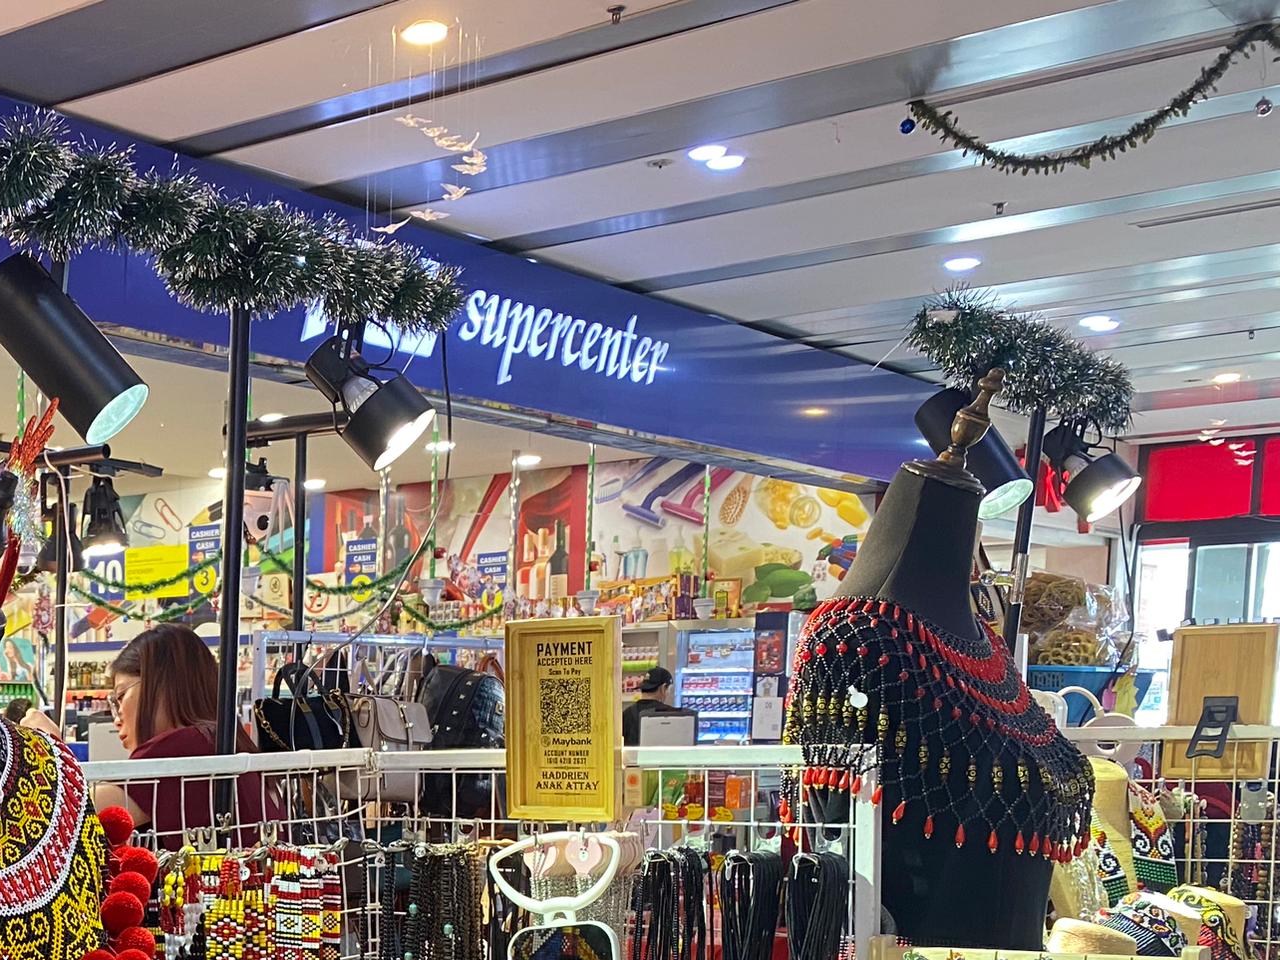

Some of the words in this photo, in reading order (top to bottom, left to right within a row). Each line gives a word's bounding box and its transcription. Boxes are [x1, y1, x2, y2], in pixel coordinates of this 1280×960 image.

[458, 289, 670, 386] supercenter
[191, 529, 220, 539] CASHIER
[196, 542, 215, 550] CASH
[349, 543, 376, 551] CASHIER
[480, 555, 507, 564] CASHIER
[200, 570, 209, 586] 3
[537, 641, 592, 656] PAYMENT
[538, 658, 572, 666] ACCEPTED
[552, 738, 592, 747] Maybank
[542, 771, 589, 780] HADDRIEN
[536, 781, 562, 790] ANAK
[566, 781, 599, 790] ATTAY
